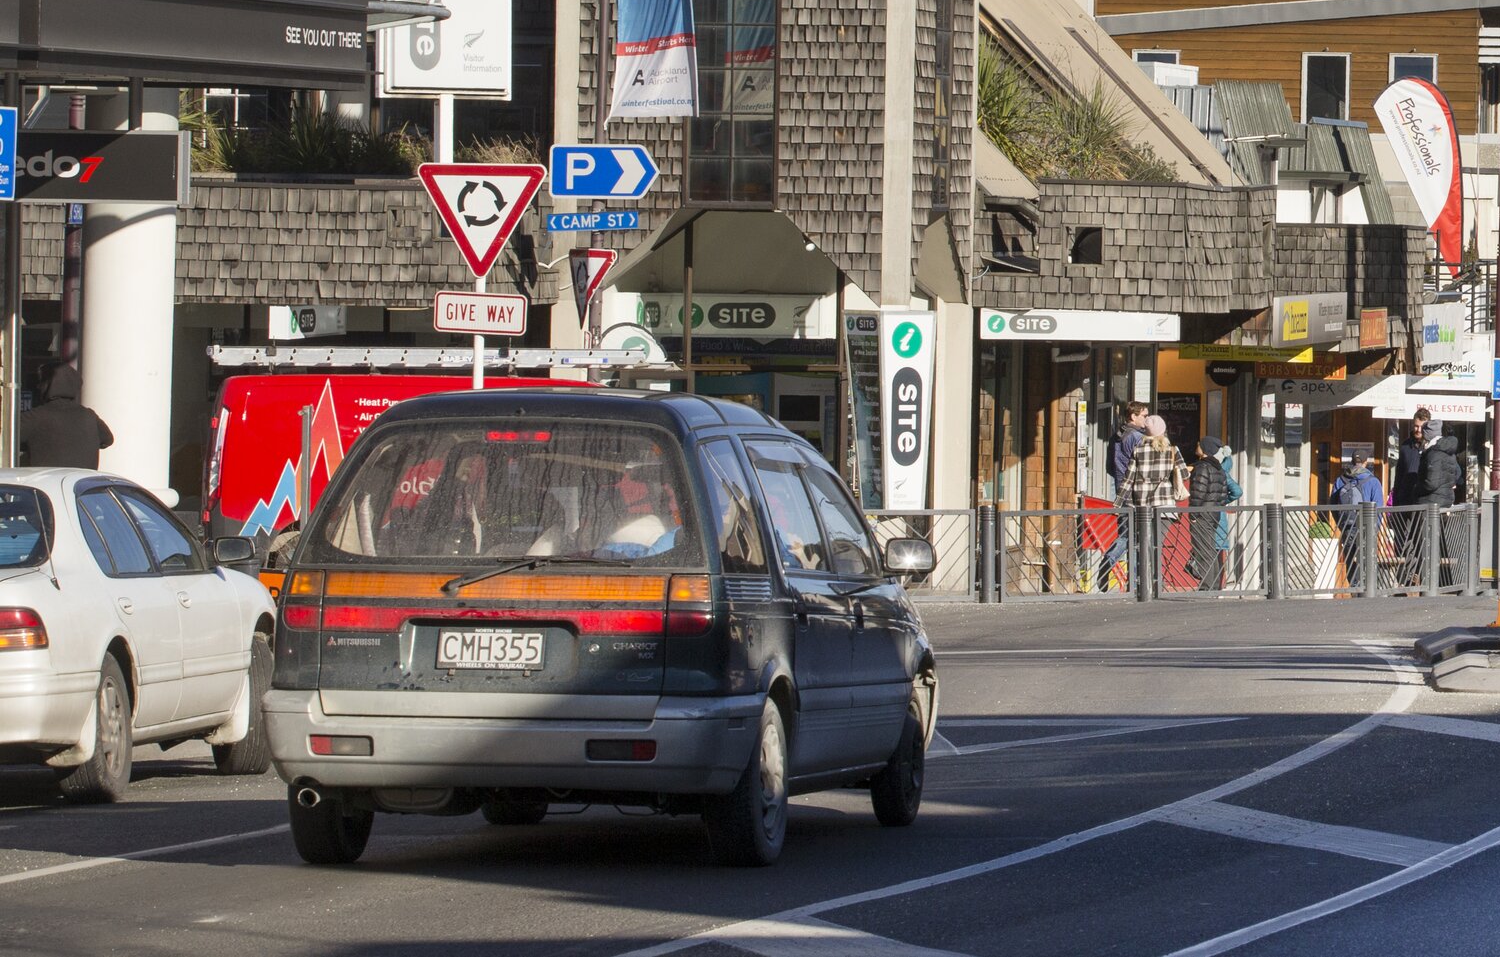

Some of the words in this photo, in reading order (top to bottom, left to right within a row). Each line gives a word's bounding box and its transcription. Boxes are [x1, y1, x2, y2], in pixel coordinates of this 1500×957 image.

[286, 26, 301, 44] SEE
[302, 28, 320, 46] YOU
[321, 29, 337, 47] OUT
[338, 31, 362, 49] THERE
[625, 46, 649, 54] Winter
[658, 38, 677, 48] Starts
[463, 53, 485, 63] Visitor
[463, 64, 502, 73] Information
[650, 66, 688, 77] Auckland
[648, 75, 678, 86] Airport
[1399, 97, 1441, 176] Professionals
[565, 152, 596, 190] P
[561, 214, 601, 229] CAMP
[607, 213, 625, 227] ST
[446, 303, 476, 322] GIVE
[487, 305, 515, 324] WAY
[1301, 378, 1335, 394] apex
[359, 398, 380, 407] Heat
[1416, 403, 1440, 413] REAL
[1441, 404, 1474, 414] ESTATE
[359, 412, 372, 421] Air
[337, 638, 381, 646] MITSUBISHI
[443, 635, 540, 661] CMH355
